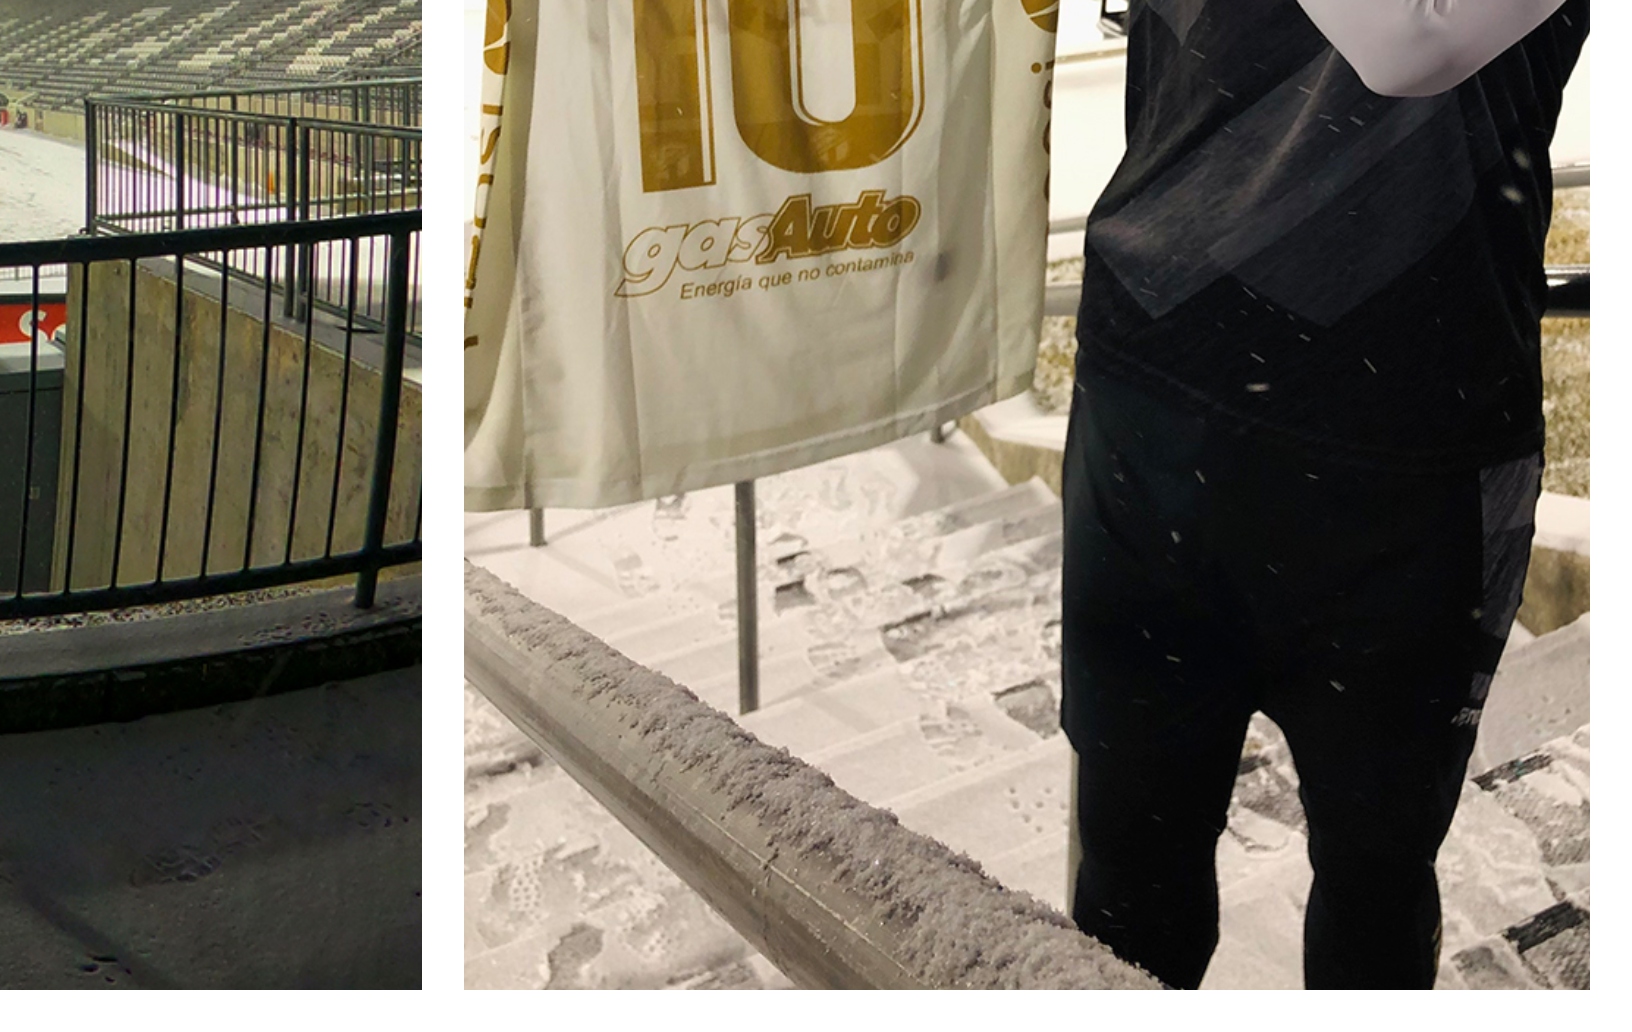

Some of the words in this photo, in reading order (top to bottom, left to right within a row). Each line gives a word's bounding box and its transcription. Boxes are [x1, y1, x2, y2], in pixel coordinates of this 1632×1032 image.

[614, 189, 922, 298] gasAuto
[679, 273, 753, 300] Energía
[758, 272, 792, 291] que
[797, 268, 820, 283] no
[825, 250, 915, 278] contamina
